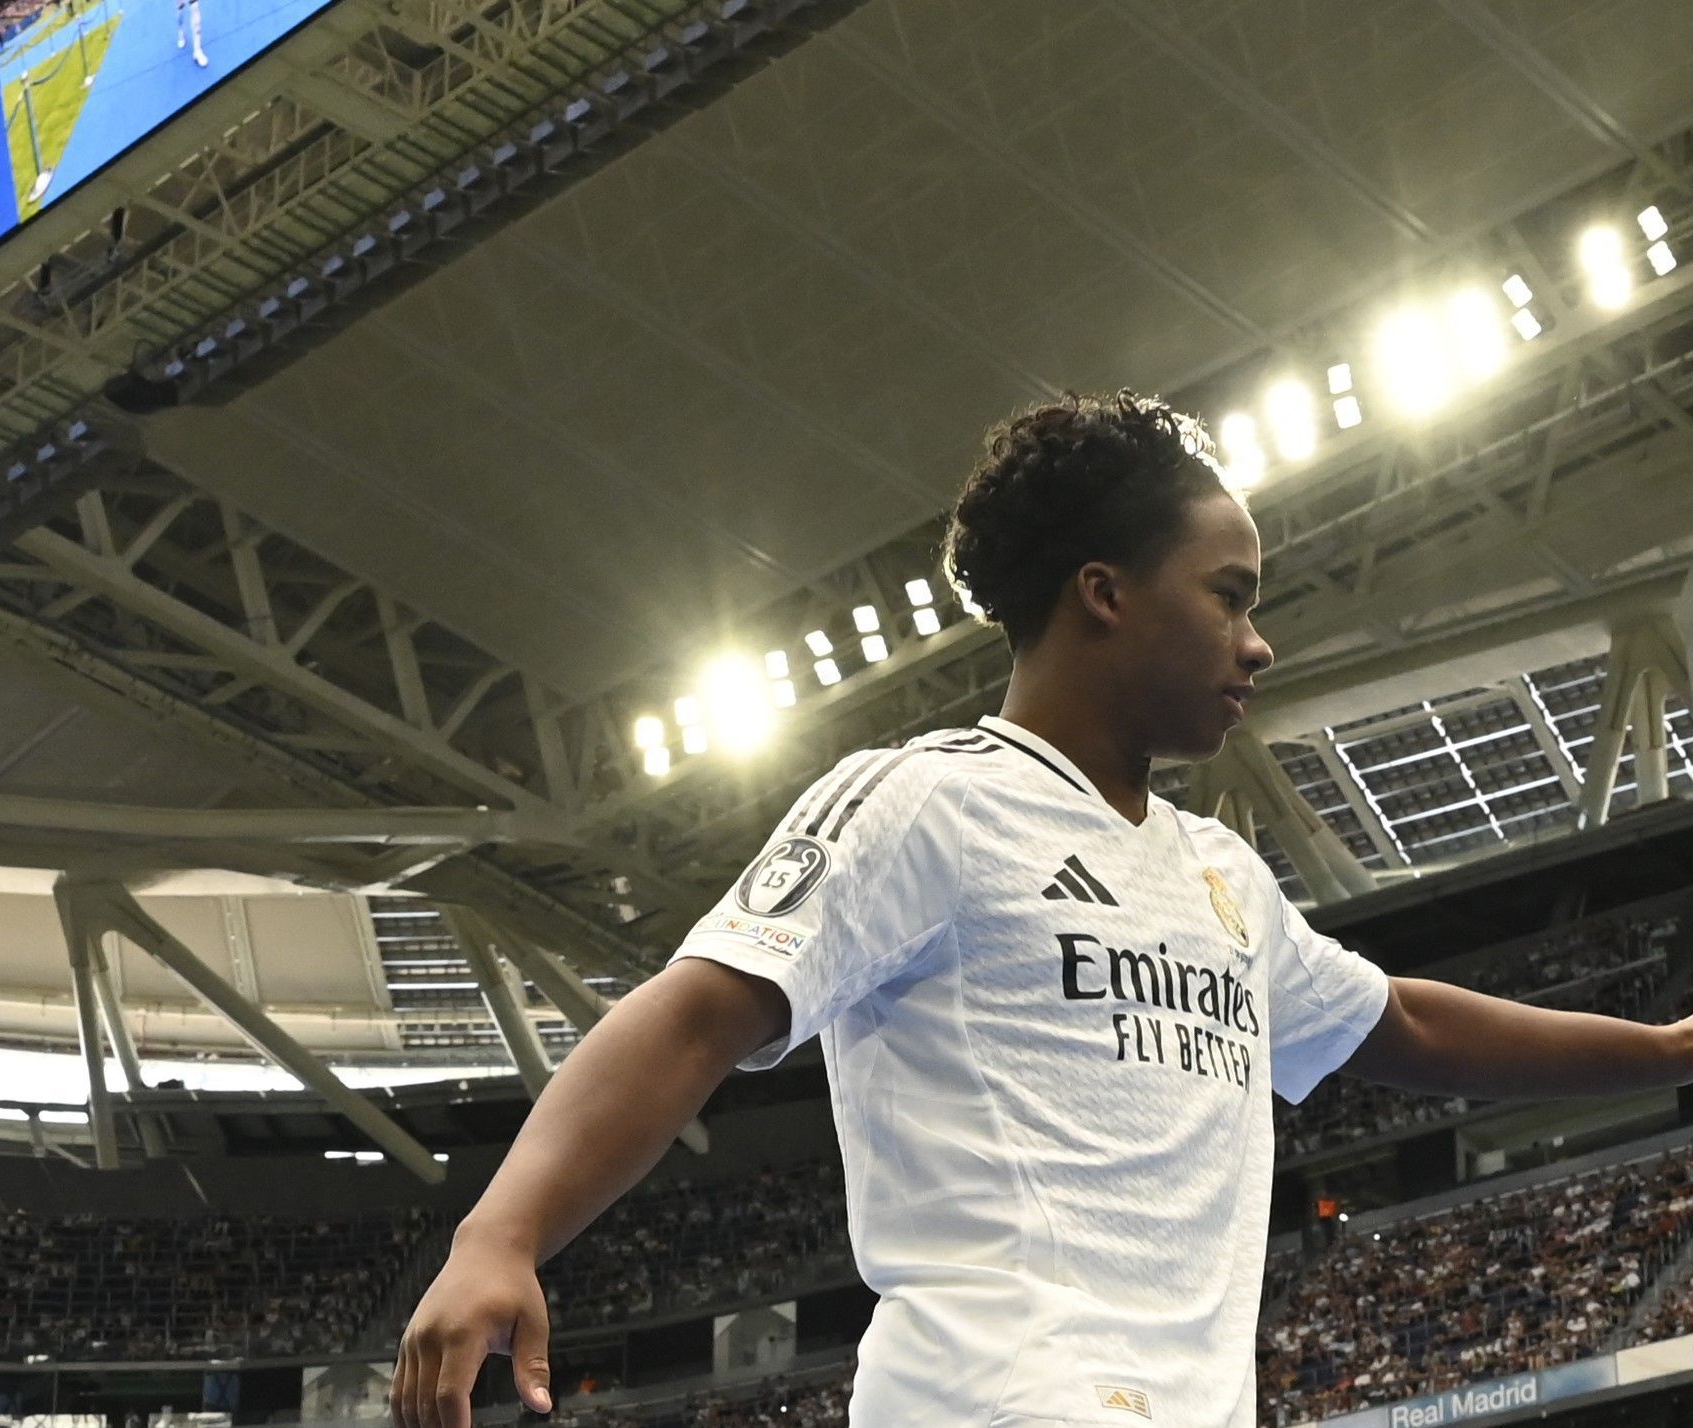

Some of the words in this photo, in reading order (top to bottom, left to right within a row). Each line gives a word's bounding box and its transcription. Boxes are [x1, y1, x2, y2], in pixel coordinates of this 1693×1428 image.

[761, 871, 790, 888] 15
[1054, 932, 1260, 1037] Emirates
[1112, 1013, 1165, 1065] FLY
[1175, 1023, 1251, 1094] BETTER
[1452, 1377, 1537, 1418] Madrid
